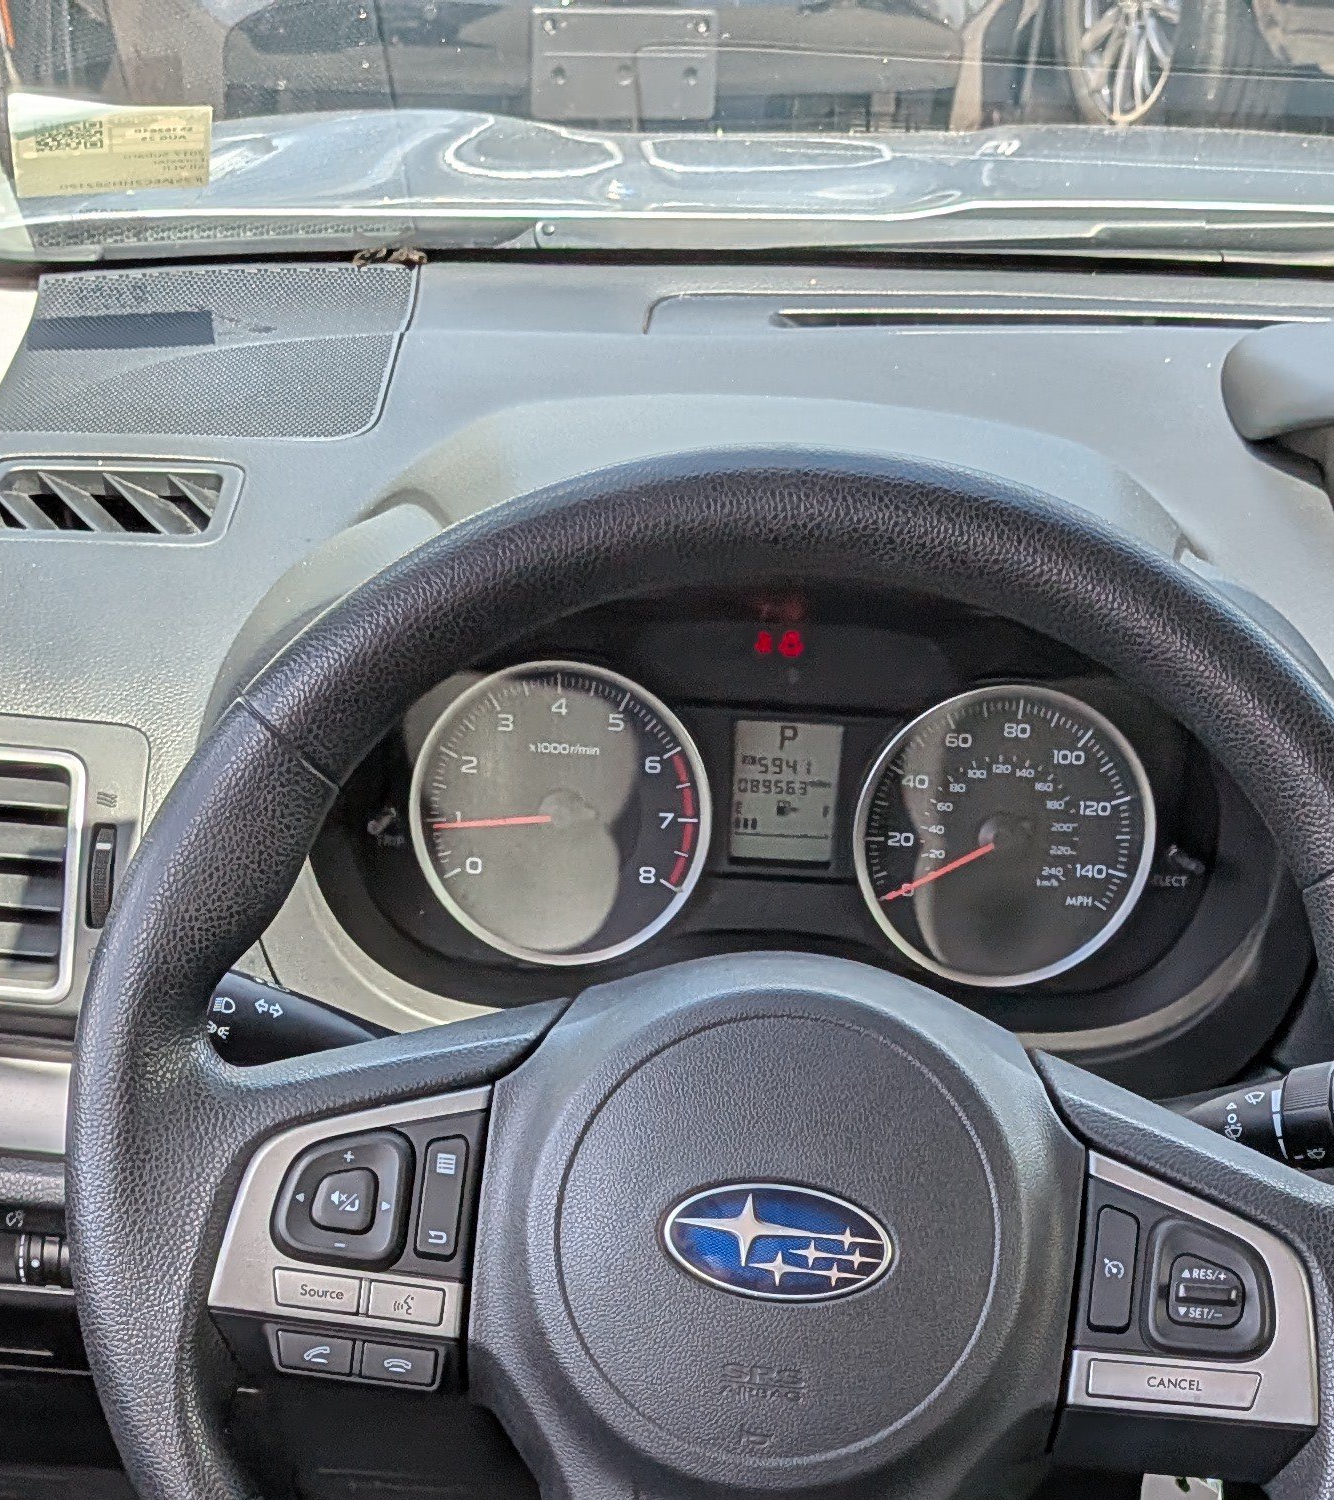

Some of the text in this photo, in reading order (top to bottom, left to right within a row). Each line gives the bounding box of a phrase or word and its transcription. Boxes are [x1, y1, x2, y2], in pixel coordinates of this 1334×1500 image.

[550, 698, 568, 716] 4
[497, 713, 515, 732] 3
[607, 713, 625, 732] 5
[778, 724, 799, 751] P
[1003, 723, 1031, 739] 80
[945, 733, 973, 748] 60
[460, 755, 478, 774] 2
[644, 756, 662, 774] 6
[1052, 749, 1085, 766] 100
[967, 769, 987, 780] 100
[992, 764, 1012, 774] 120
[1015, 768, 1035, 779] 140
[901, 774, 929, 789] 40
[949, 783, 966, 793] 80
[936, 801, 953, 812] 60
[1079, 800, 1112, 817] 120
[658, 812, 675, 830] 7
[928, 824, 945, 835] 40
[887, 832, 914, 848] 20
[928, 849, 946, 860] 20
[465, 856, 483, 875] 0
[1075, 864, 1107, 879] 140
[638, 866, 656, 884] 8
[1065, 896, 1093, 907] MPH
[298, 1282, 346, 1303] Source
[1146, 1374, 1203, 1393] CANCEL
